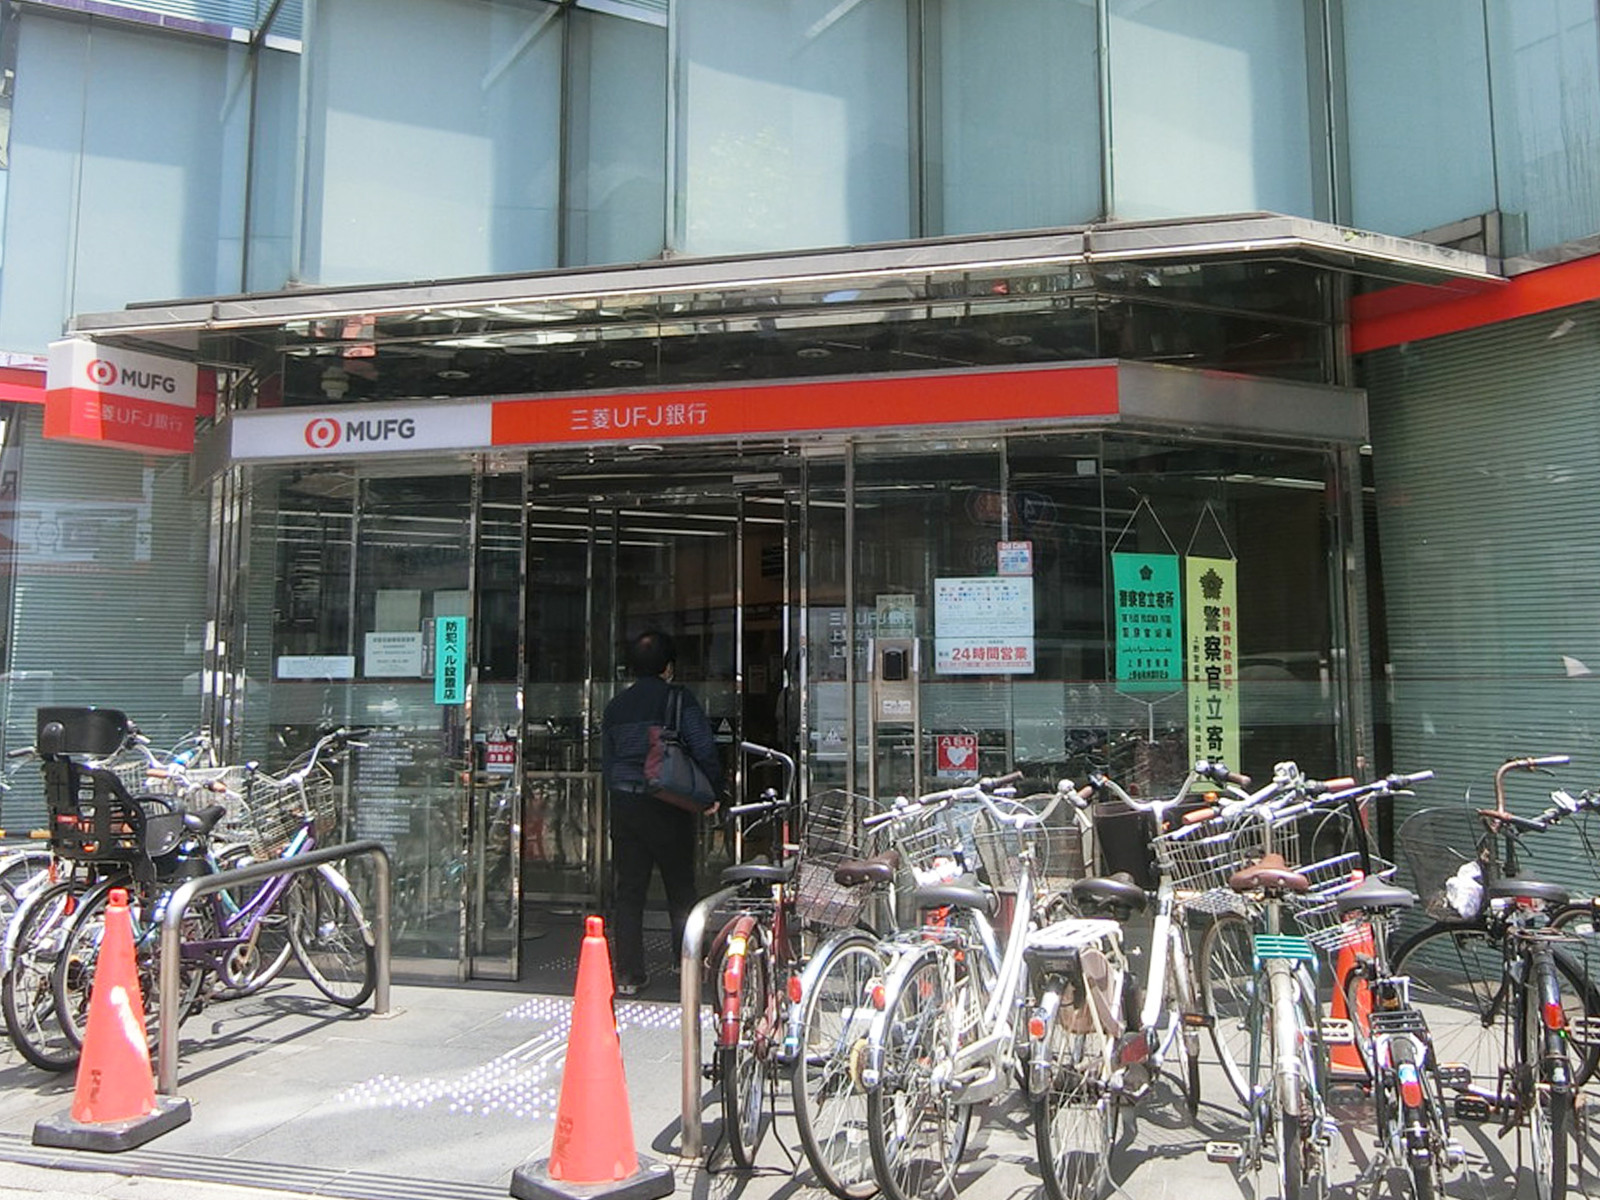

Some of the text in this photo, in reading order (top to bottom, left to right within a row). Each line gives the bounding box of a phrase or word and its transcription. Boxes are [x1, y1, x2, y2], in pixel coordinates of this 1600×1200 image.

[121, 368, 176, 394] MUFG
[83, 401, 182, 433] 三菱UFJ銀行
[571, 403, 708, 431] 三菱UFJ銀行
[346, 419, 415, 442] MUFG
[443, 621, 458, 699] 防犯ベル設置店
[951, 646, 1027, 661] 24時間営業
[941, 737, 974, 746] AED
